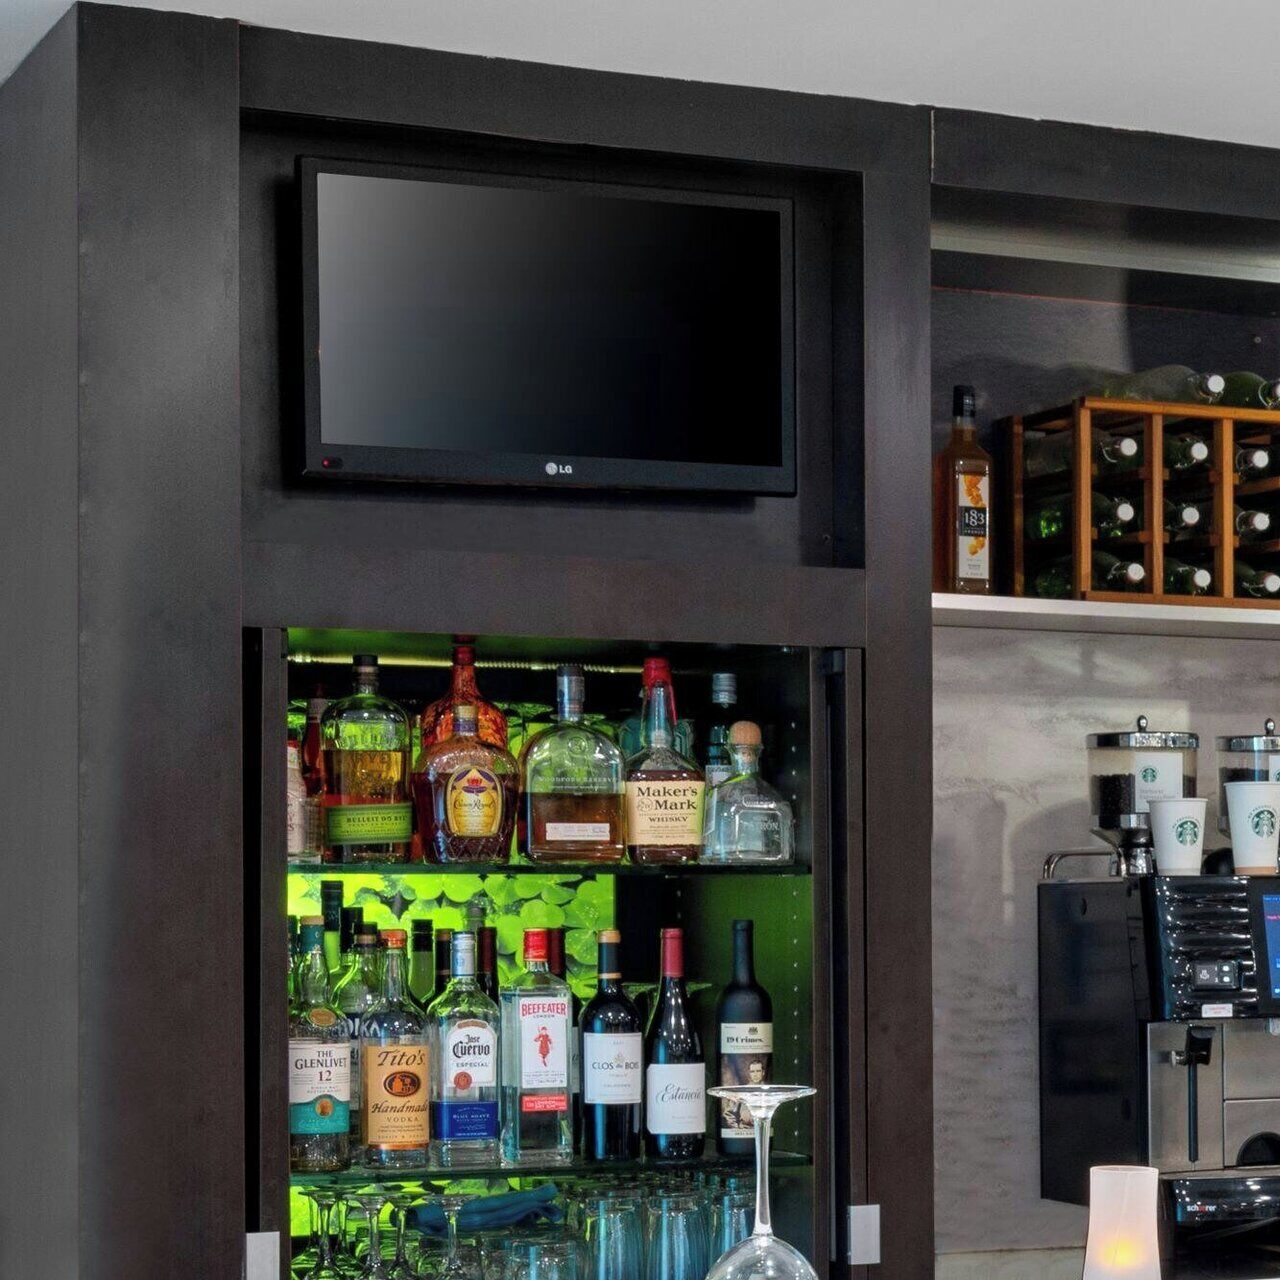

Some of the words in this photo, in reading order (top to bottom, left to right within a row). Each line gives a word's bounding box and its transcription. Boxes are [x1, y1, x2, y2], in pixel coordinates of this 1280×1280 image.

[559, 465, 573, 474] LG
[637, 786, 698, 797] Maker's
[655, 799, 697, 810] Mark
[521, 1002, 567, 1017] BEEFEATER
[465, 1034, 481, 1045] Jose
[316, 1050, 334, 1058] THE
[452, 1040, 491, 1059] Cuervo
[377, 1048, 426, 1067] Tito's
[294, 1057, 347, 1070] GLENLIVET
[591, 1062, 614, 1070] CLOS
[318, 1070, 332, 1082] 12
